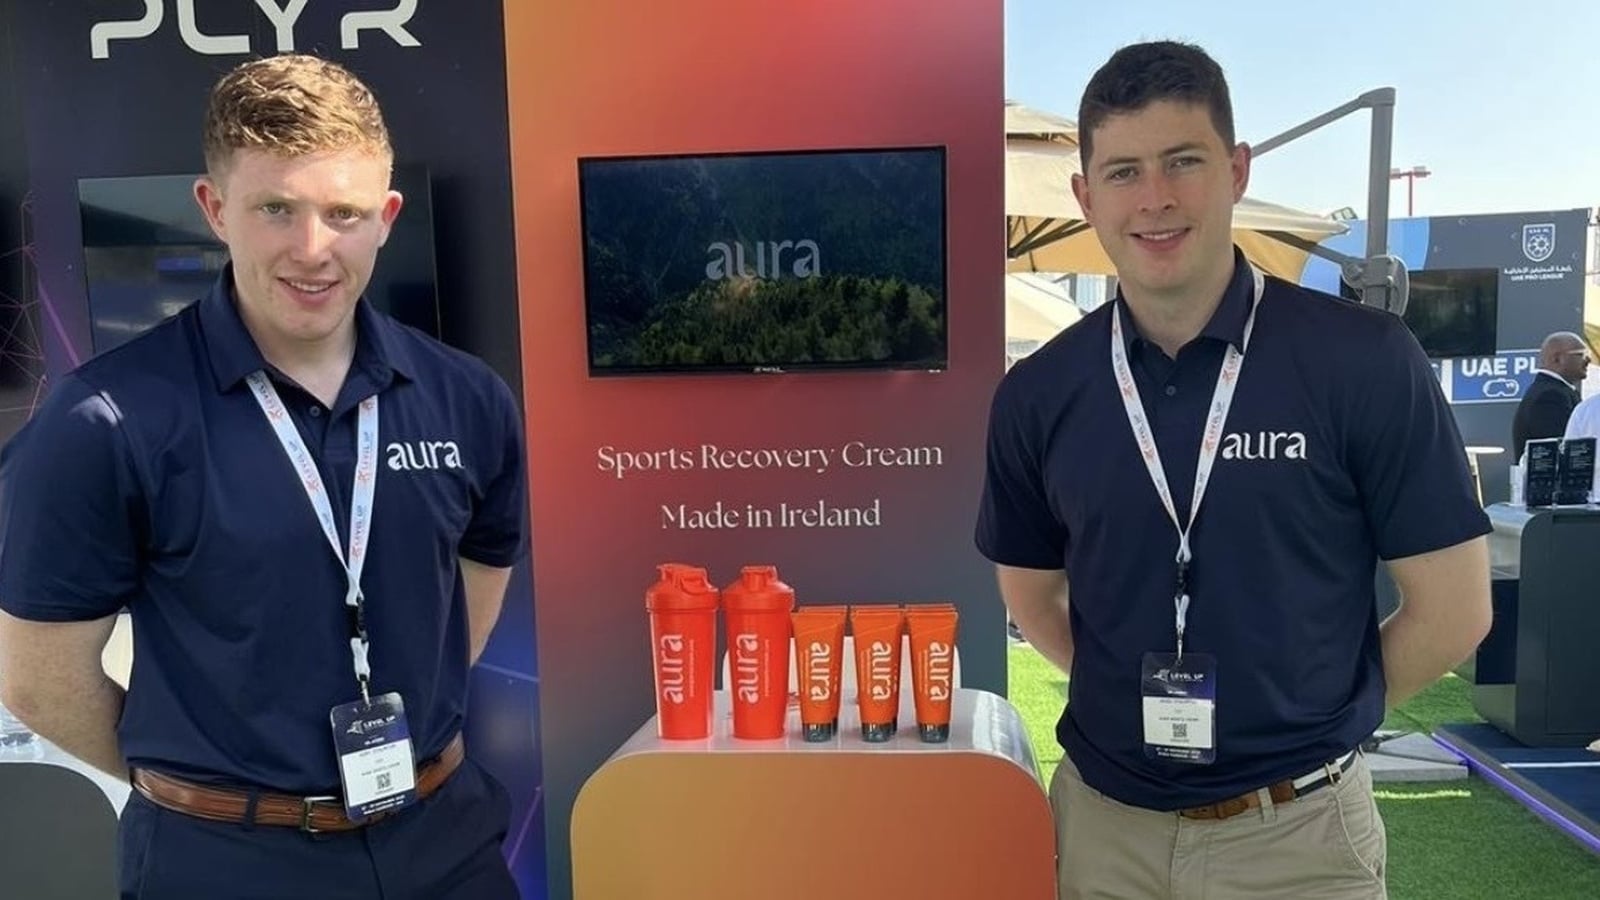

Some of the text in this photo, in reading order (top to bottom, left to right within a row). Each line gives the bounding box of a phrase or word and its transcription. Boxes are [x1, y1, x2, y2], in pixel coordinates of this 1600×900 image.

[705, 238, 822, 281] aura
[1461, 357, 1508, 377] UAE
[387, 441, 464, 470] aura
[597, 441, 943, 479] Sports Recovery Cream
[1222, 431, 1308, 460] aura
[661, 499, 881, 529] Made in Ireland
[660, 634, 683, 704] aura
[736, 634, 759, 704] aura
[811, 642, 830, 700] aura
[872, 641, 891, 700] aura
[929, 642, 949, 700] aura
